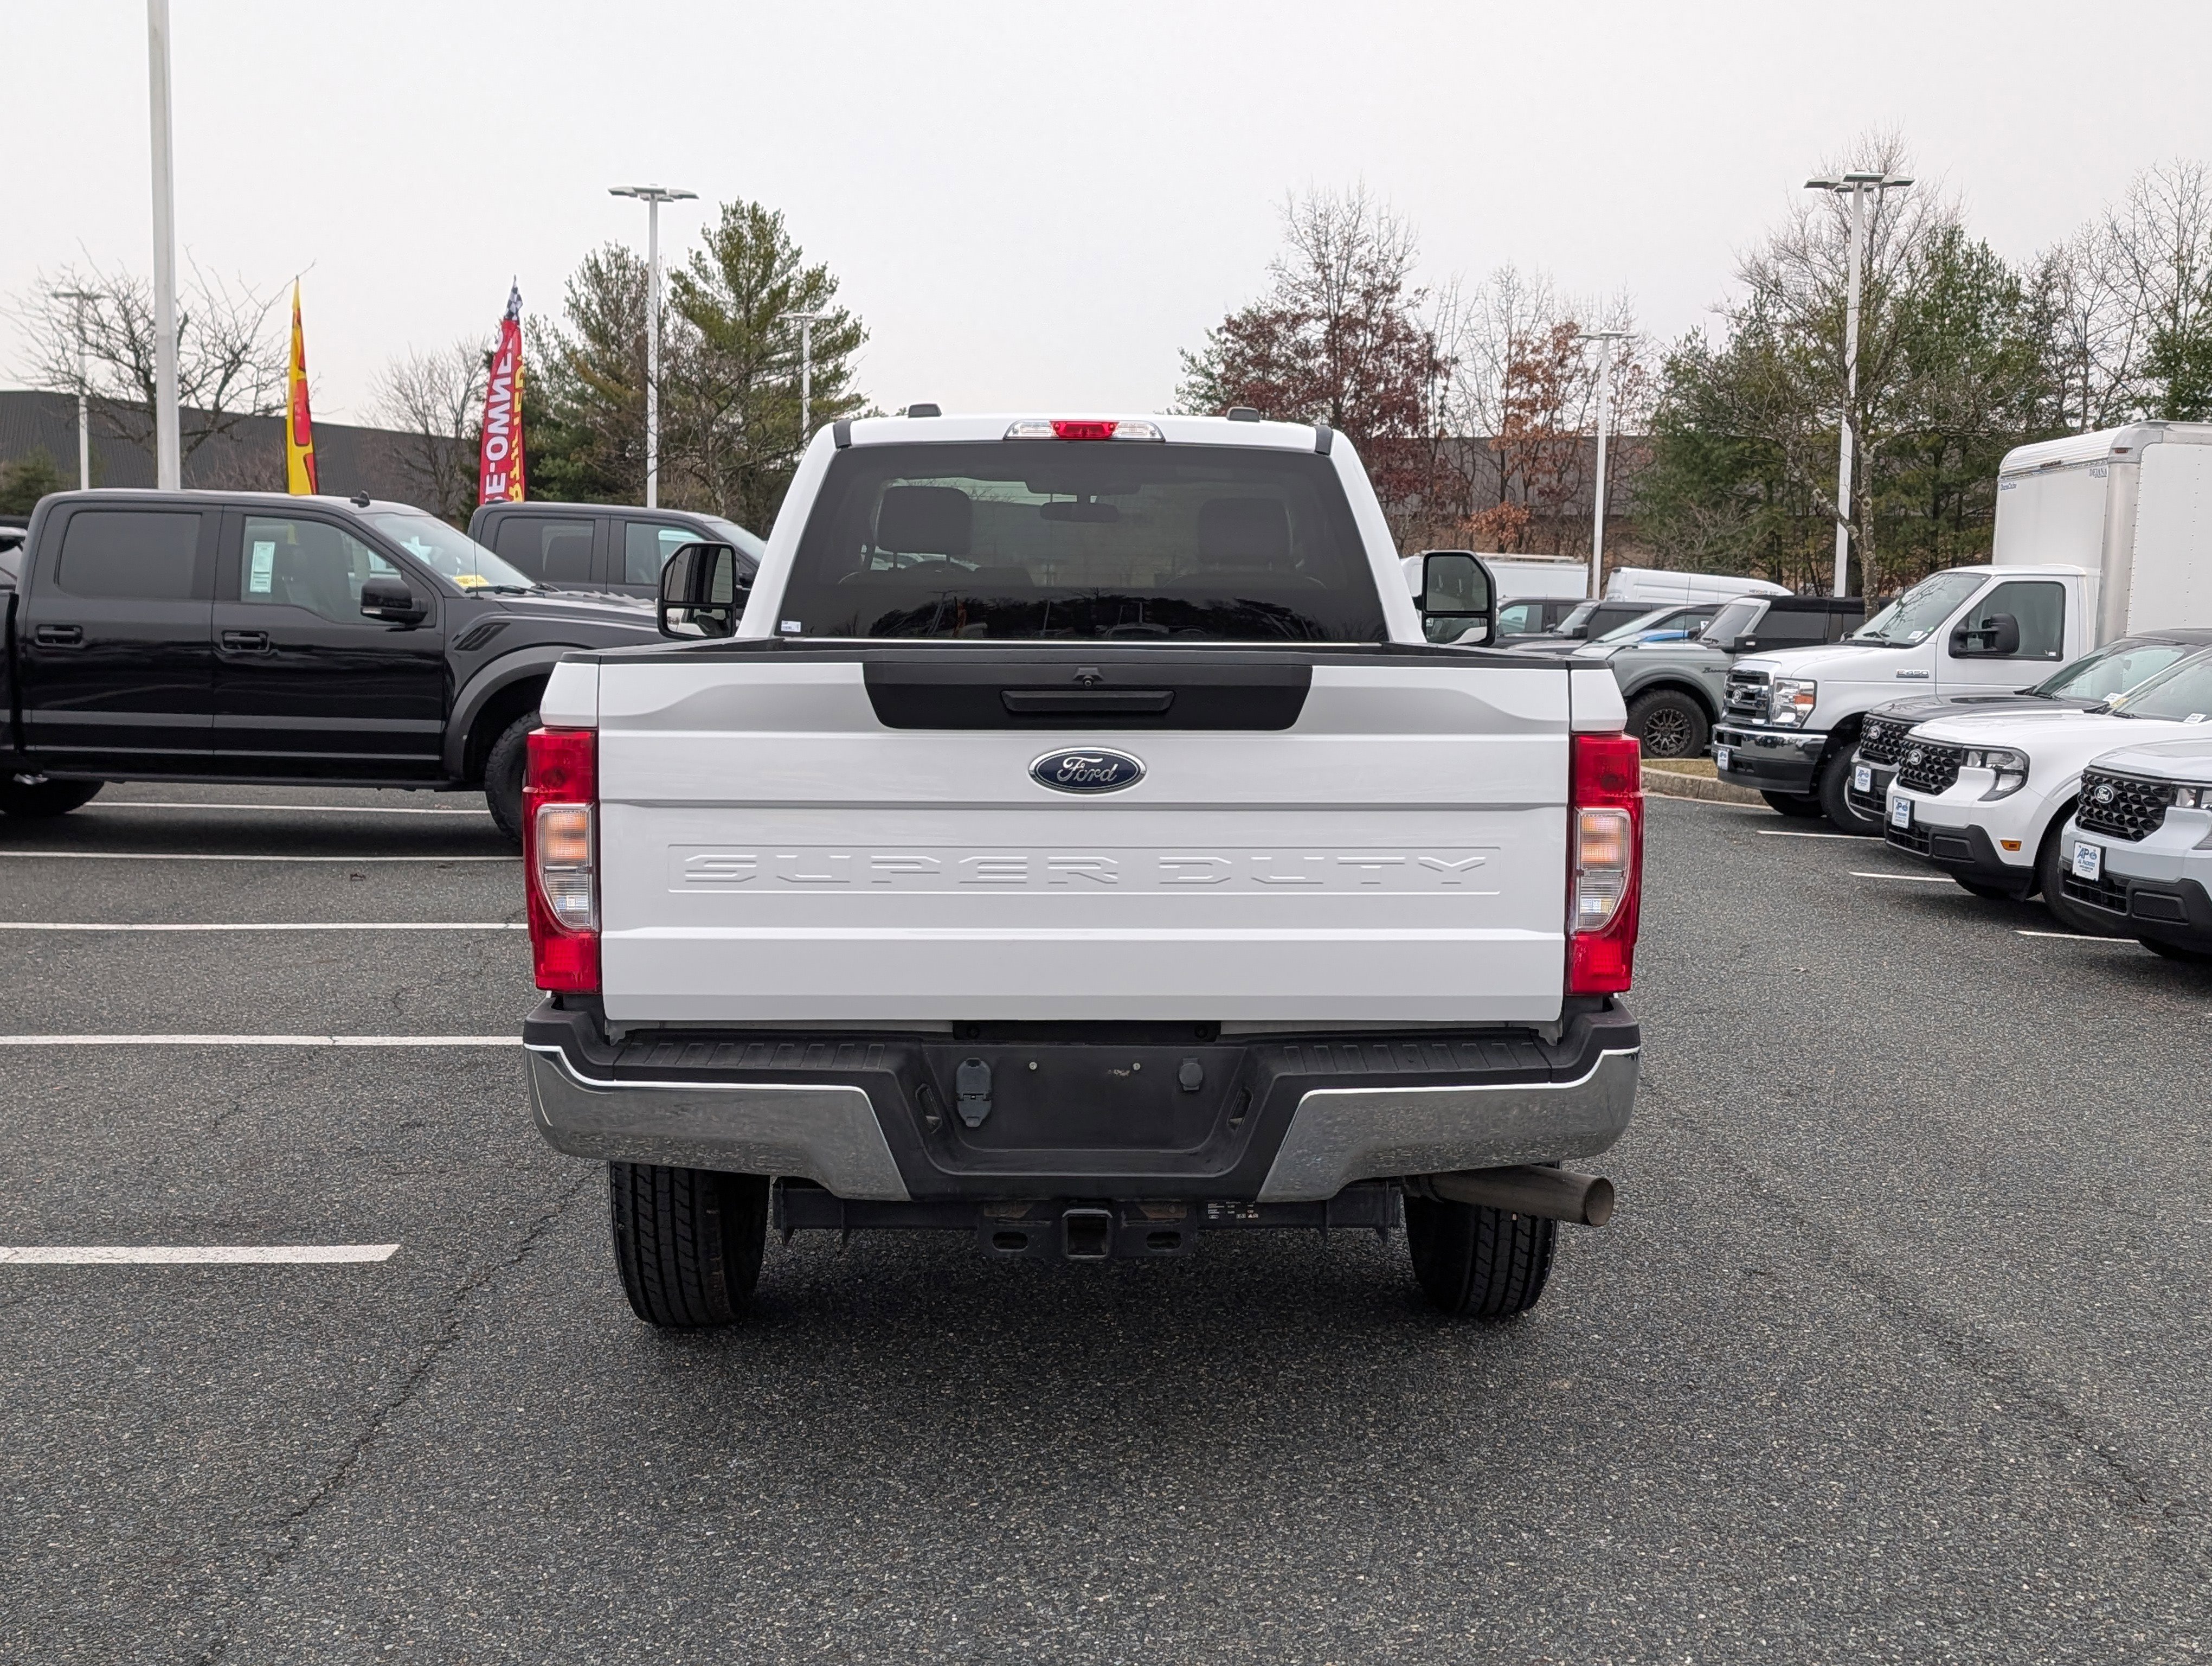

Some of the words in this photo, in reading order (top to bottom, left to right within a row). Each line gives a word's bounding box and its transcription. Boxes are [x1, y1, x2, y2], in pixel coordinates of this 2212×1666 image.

[1057, 757, 1118, 782] Ford
[2097, 787, 2110, 800] Ford
[2077, 847, 2089, 859] AP
[685, 854, 1118, 885] SUPER
[1159, 855, 1487, 886] DUTY
